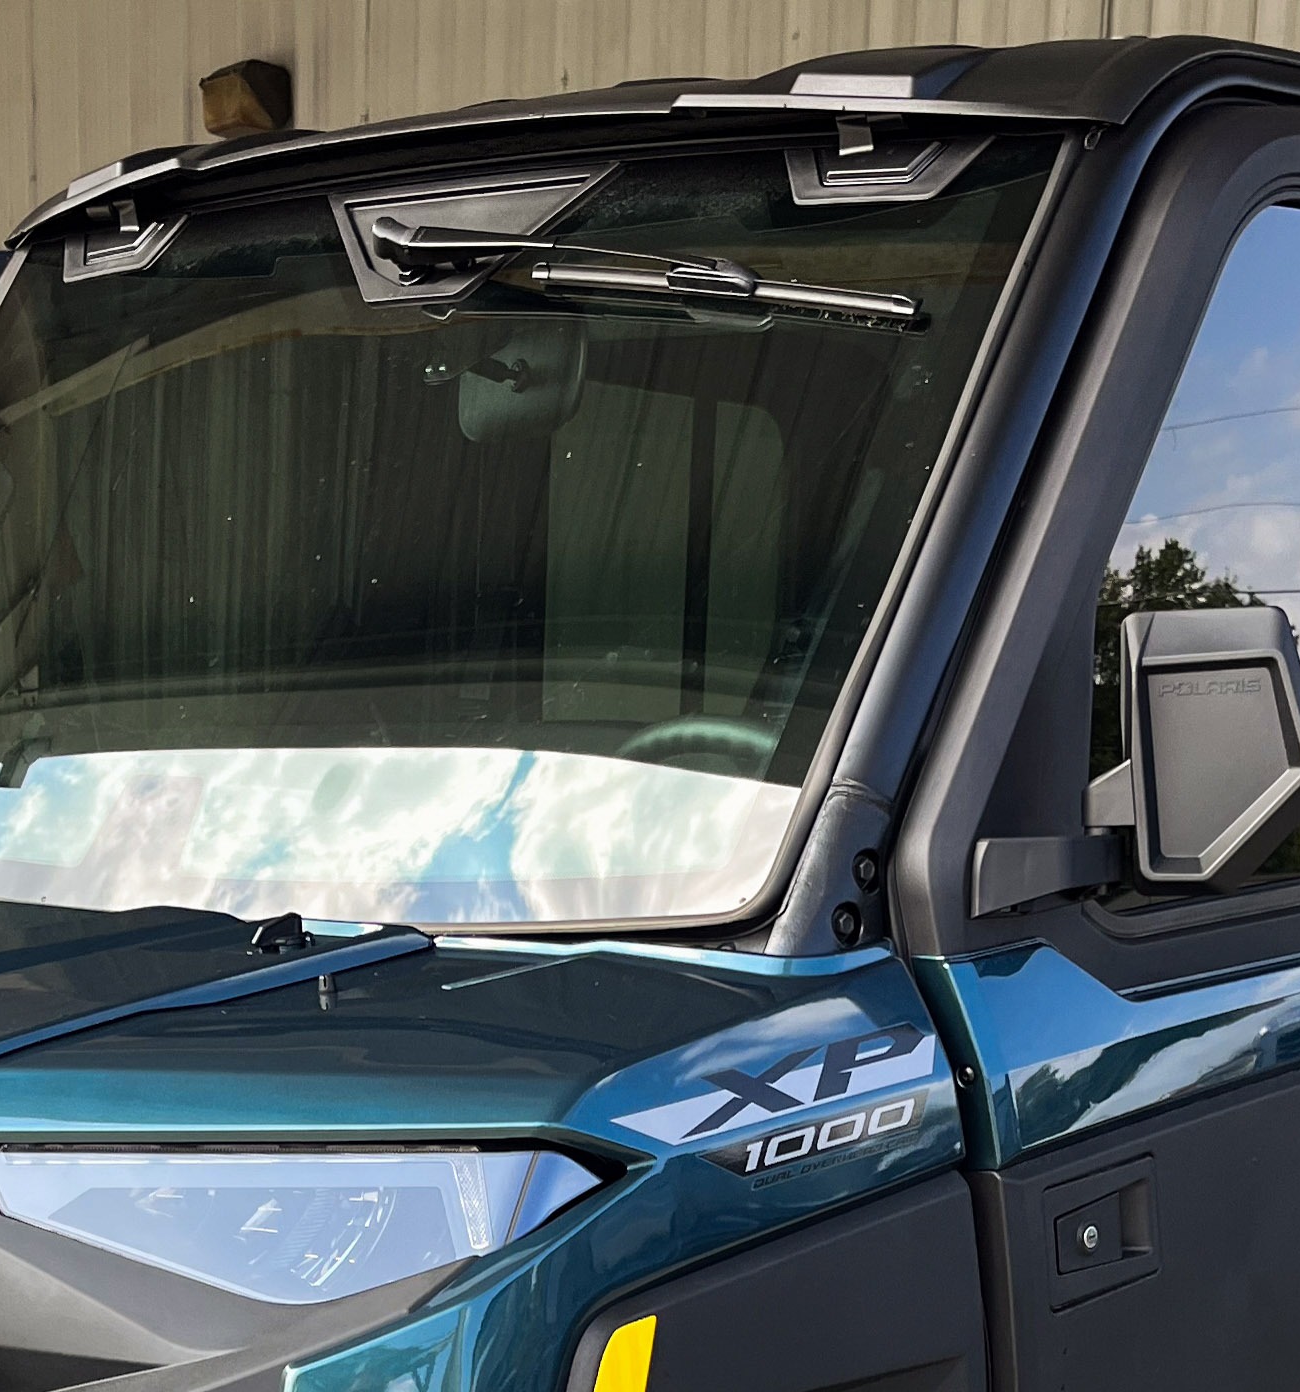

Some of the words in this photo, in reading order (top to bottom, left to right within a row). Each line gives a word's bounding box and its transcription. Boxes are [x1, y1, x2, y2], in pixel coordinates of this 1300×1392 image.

[1158, 679, 1263, 698] POLARIS
[679, 1021, 925, 1140] XP
[744, 1098, 916, 1173] 1000
